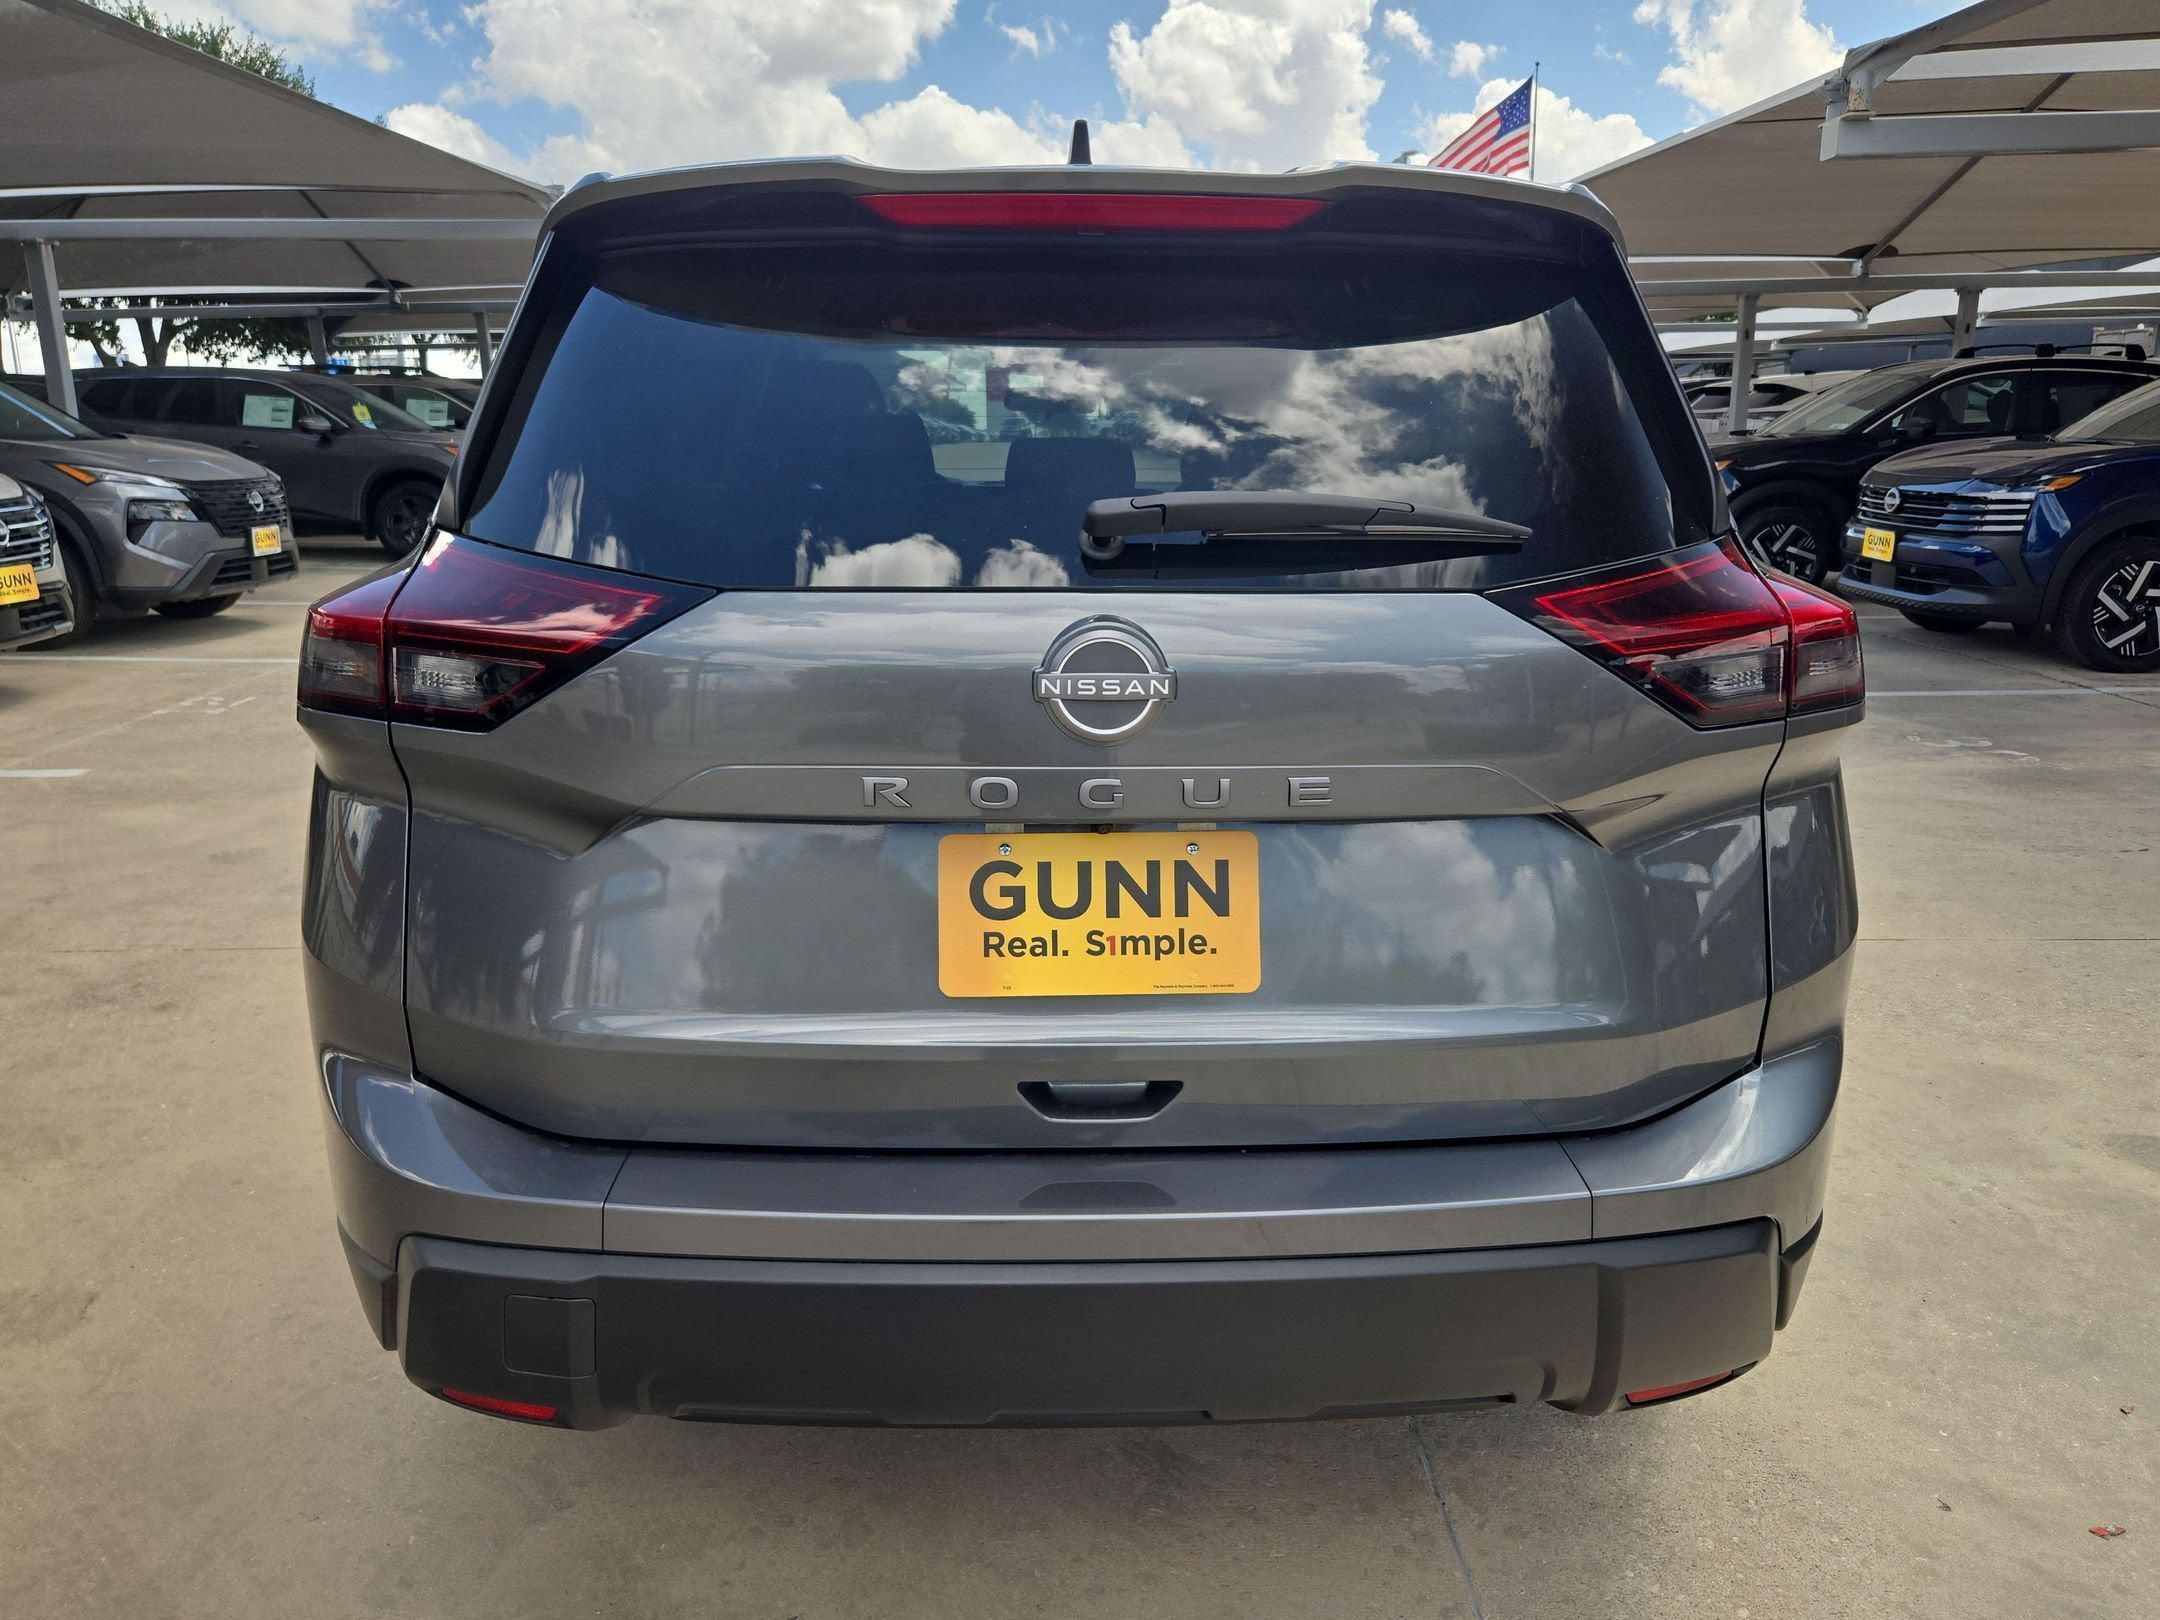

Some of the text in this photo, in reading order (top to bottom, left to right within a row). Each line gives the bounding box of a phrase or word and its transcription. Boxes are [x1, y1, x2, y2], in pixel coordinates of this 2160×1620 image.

[1868, 535, 1891, 548] GUNN
[1041, 678, 1169, 695] NISSAN
[861, 776, 1333, 809] ROGUE
[968, 859, 1230, 921] GUNN
[983, 929, 1069, 958] Real.
